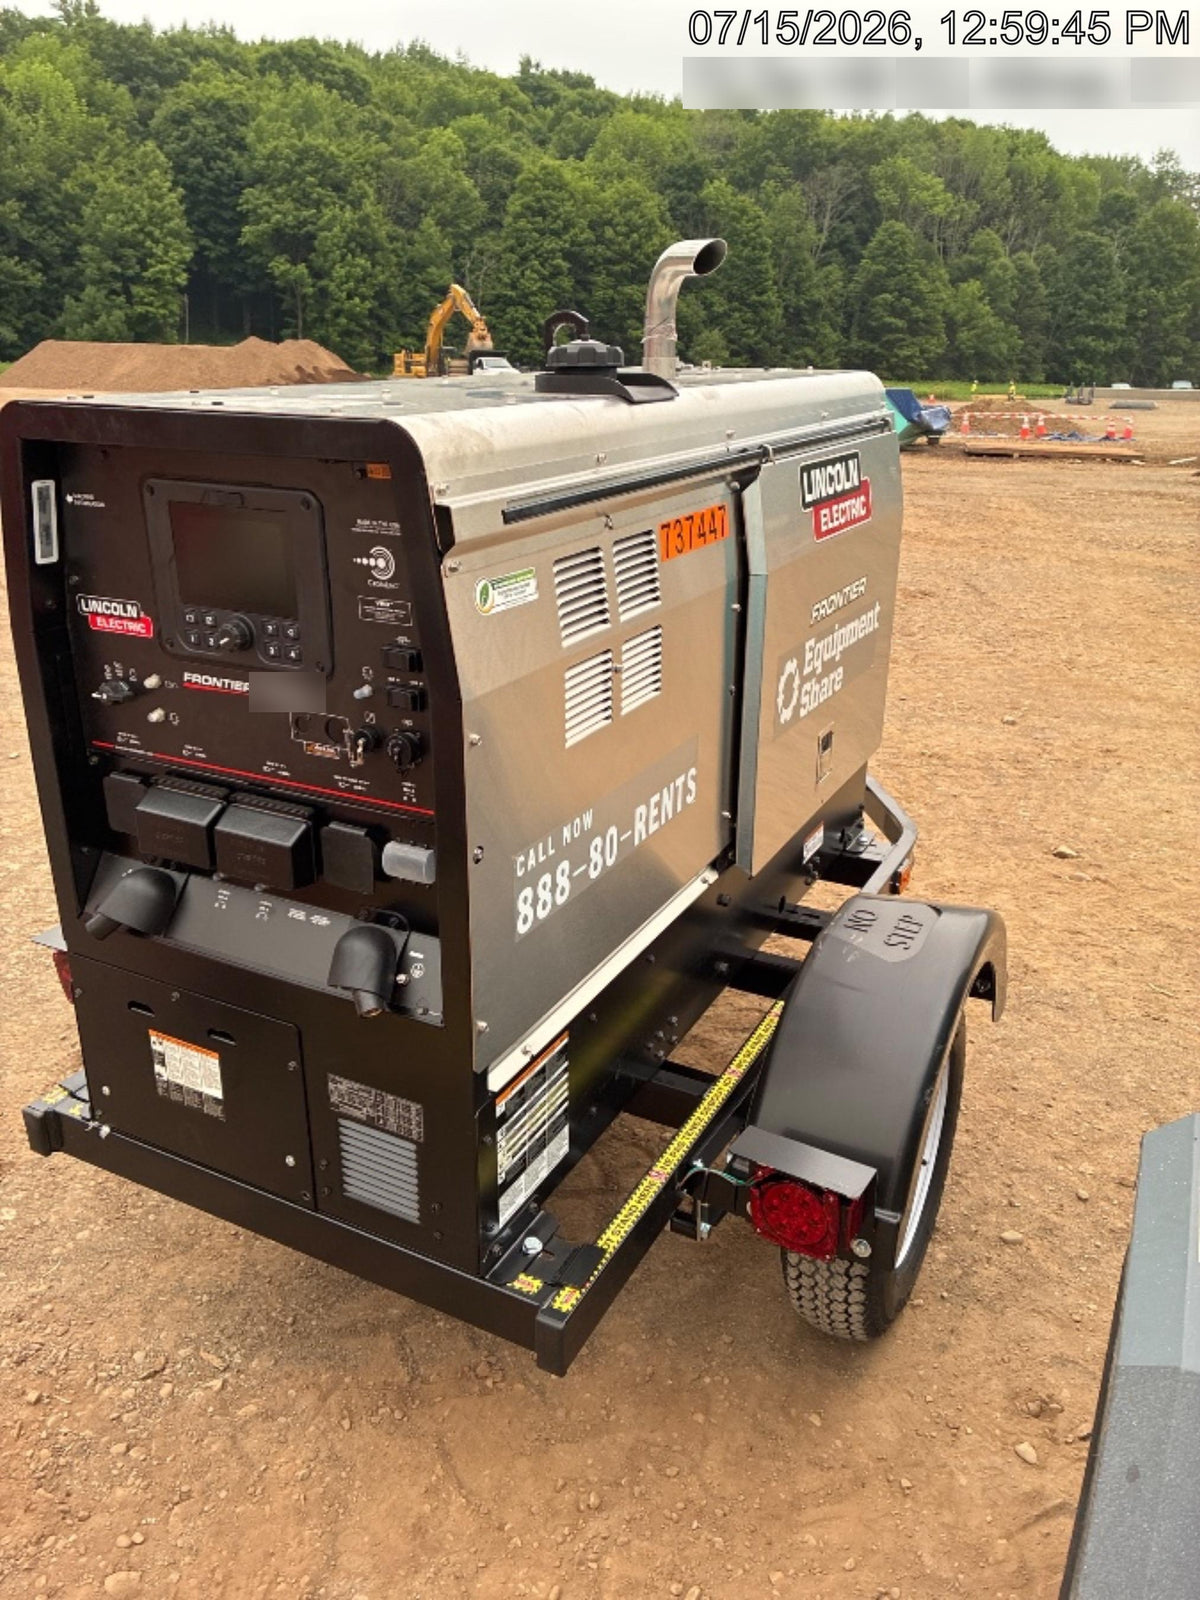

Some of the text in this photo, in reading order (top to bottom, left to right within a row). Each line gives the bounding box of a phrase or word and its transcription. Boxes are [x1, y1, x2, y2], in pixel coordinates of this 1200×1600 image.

[802, 457, 860, 503] LINCOLN
[660, 504, 727, 559] 737447
[820, 496, 867, 533] ELECTRIC
[80, 598, 138, 619] LINCOLN
[96, 617, 147, 633] ELECTRIC
[810, 576, 868, 626] FRONTIER
[803, 602, 881, 676] Equipment
[800, 666, 844, 719] Share
[516, 808, 593, 877] CALL NOW
[516, 767, 697, 934] 888-80-RENTS
[844, 909, 879, 933] NO
[883, 914, 924, 951] STEP
